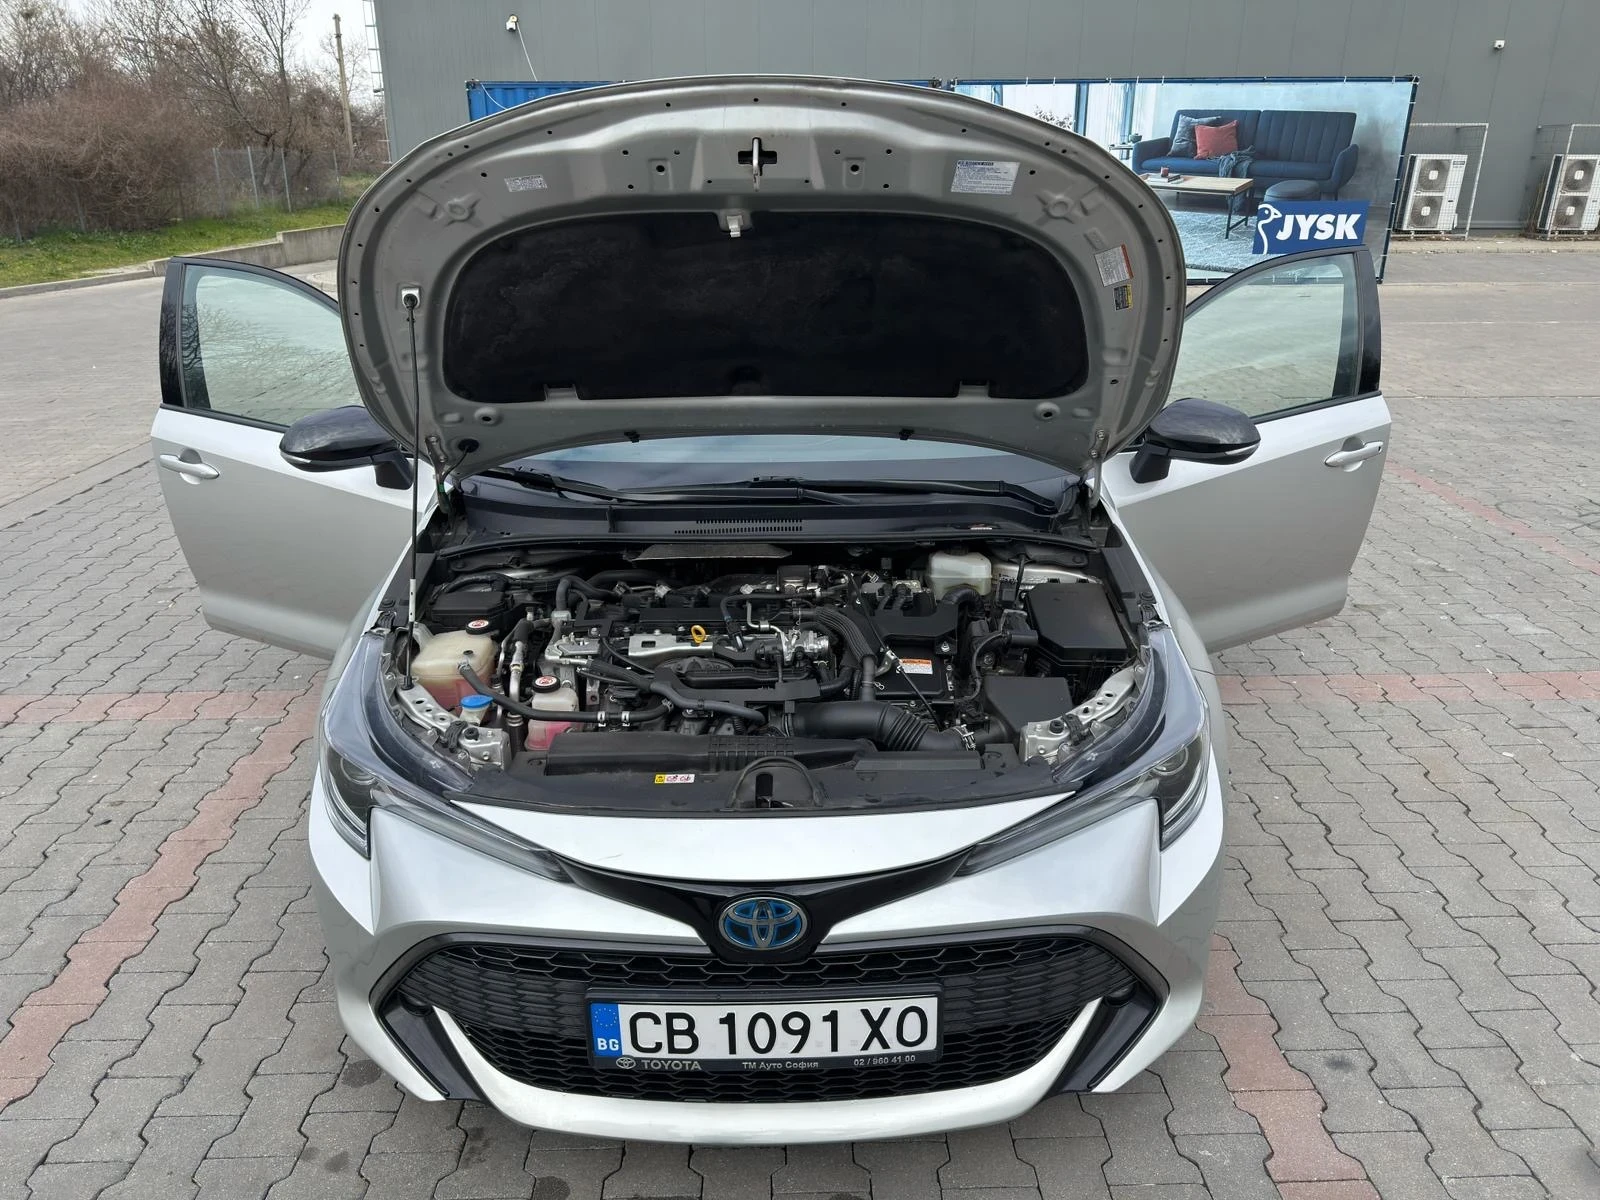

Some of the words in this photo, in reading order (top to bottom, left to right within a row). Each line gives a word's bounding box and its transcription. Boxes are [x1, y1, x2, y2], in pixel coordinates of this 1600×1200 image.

[1276, 214, 1361, 240] JYSK
[628, 1011, 699, 1054] CB
[719, 1009, 838, 1055] 1091
[859, 1005, 928, 1051] XO
[597, 1037, 619, 1051] BG
[641, 1059, 702, 1071] TOYOTA
[785, 1061, 819, 1071] София
[853, 1058, 865, 1066] 02
